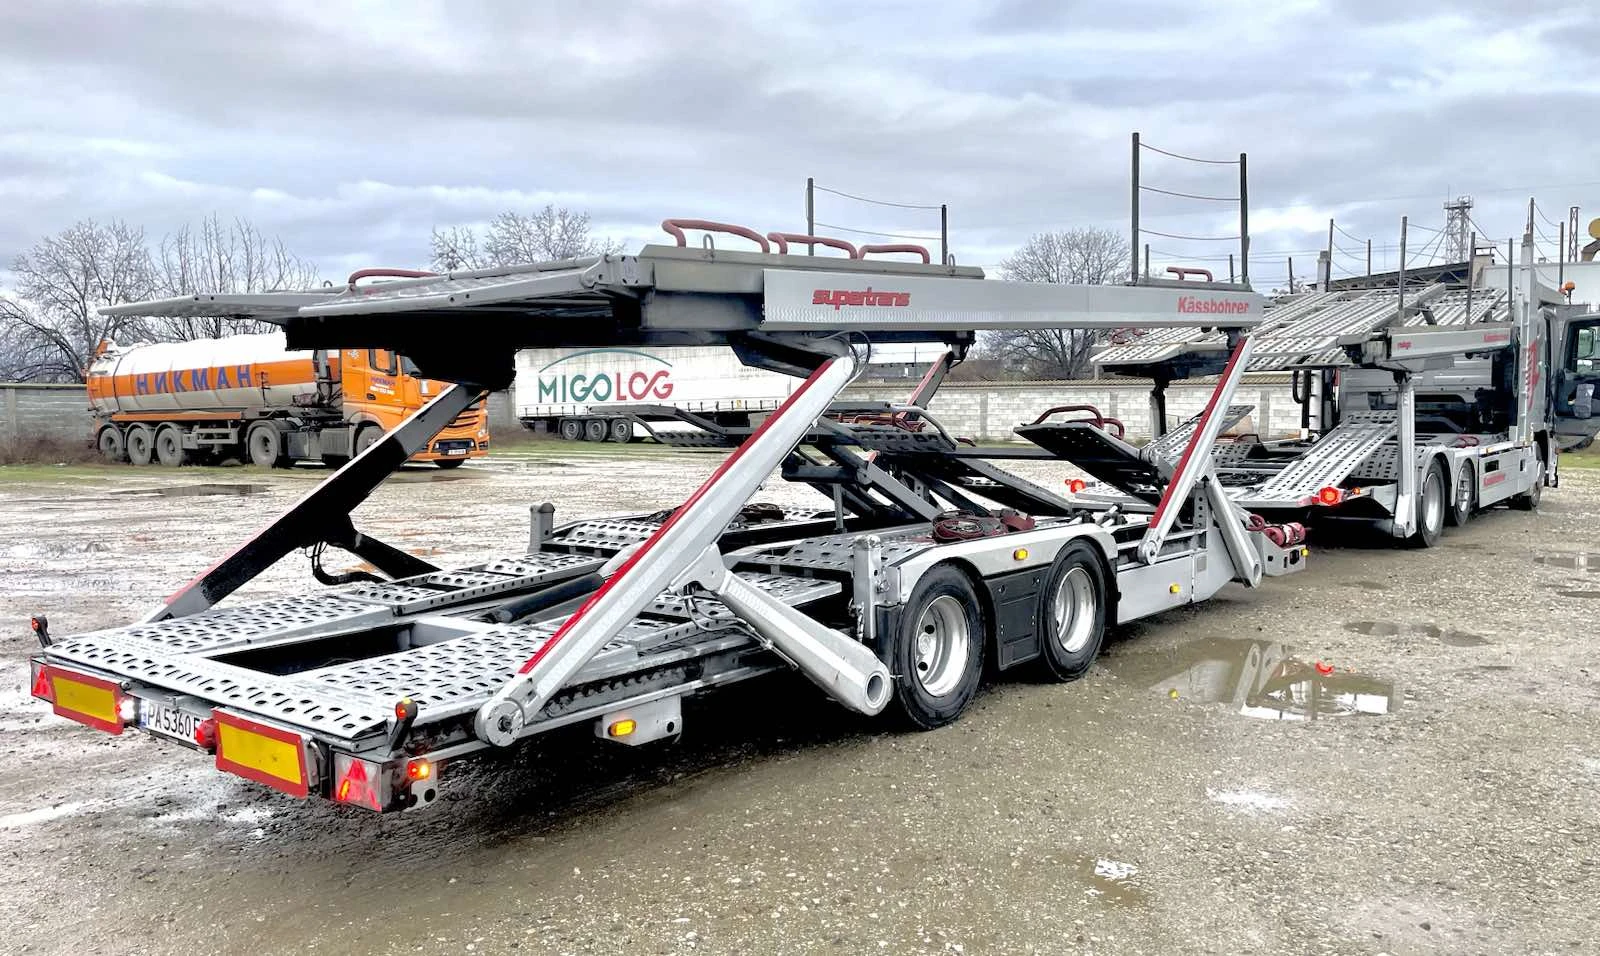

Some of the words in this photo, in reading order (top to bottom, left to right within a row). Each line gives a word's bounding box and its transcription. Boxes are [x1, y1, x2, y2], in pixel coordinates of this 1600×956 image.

[813, 287, 910, 310] supertrans
[1178, 295, 1249, 313] Kässbohrer
[136, 365, 252, 396] НИКМАН
[538, 370, 674, 403] MIGOLOG
